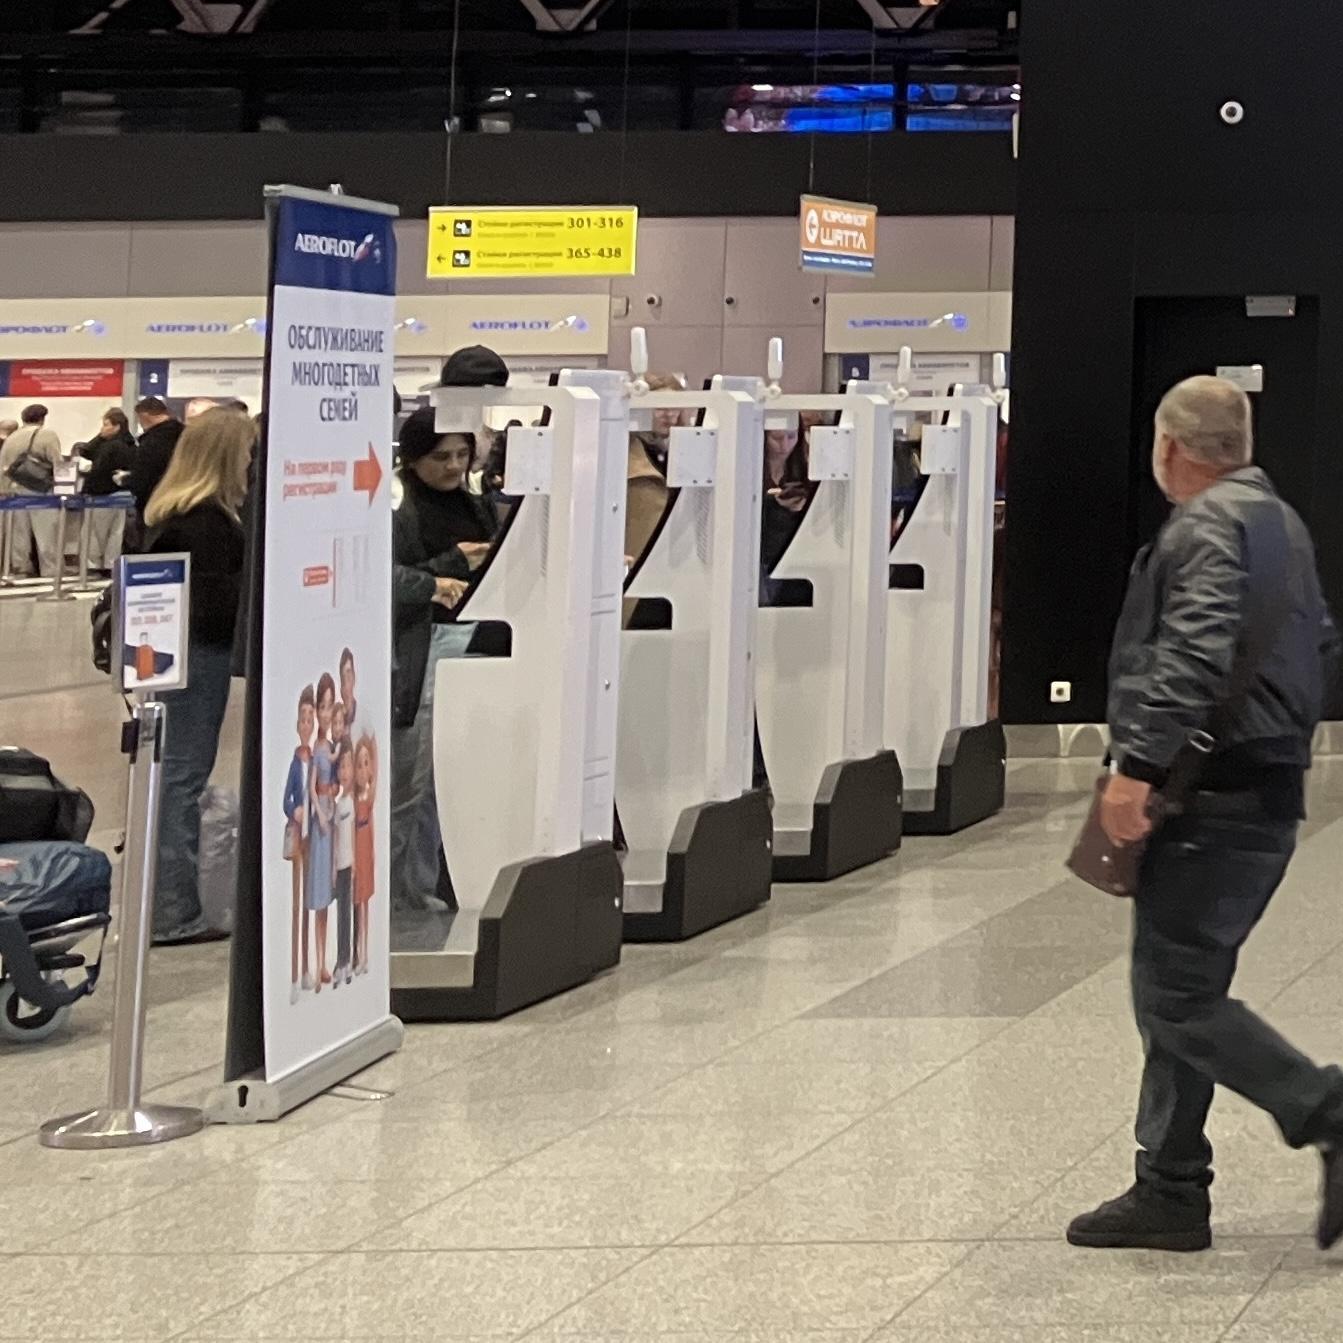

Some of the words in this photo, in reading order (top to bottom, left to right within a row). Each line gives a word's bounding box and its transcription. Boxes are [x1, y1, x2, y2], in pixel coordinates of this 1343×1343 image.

[568, 217, 624, 229] 301-316
[294, 232, 357, 258] AEROFLOT
[287, 324, 385, 354] ОБСЛУЖИВАНИЕ
[291, 361, 381, 391] МНОГОДЕТНЫХ
[318, 392, 358, 423] СЕМЕЙ
